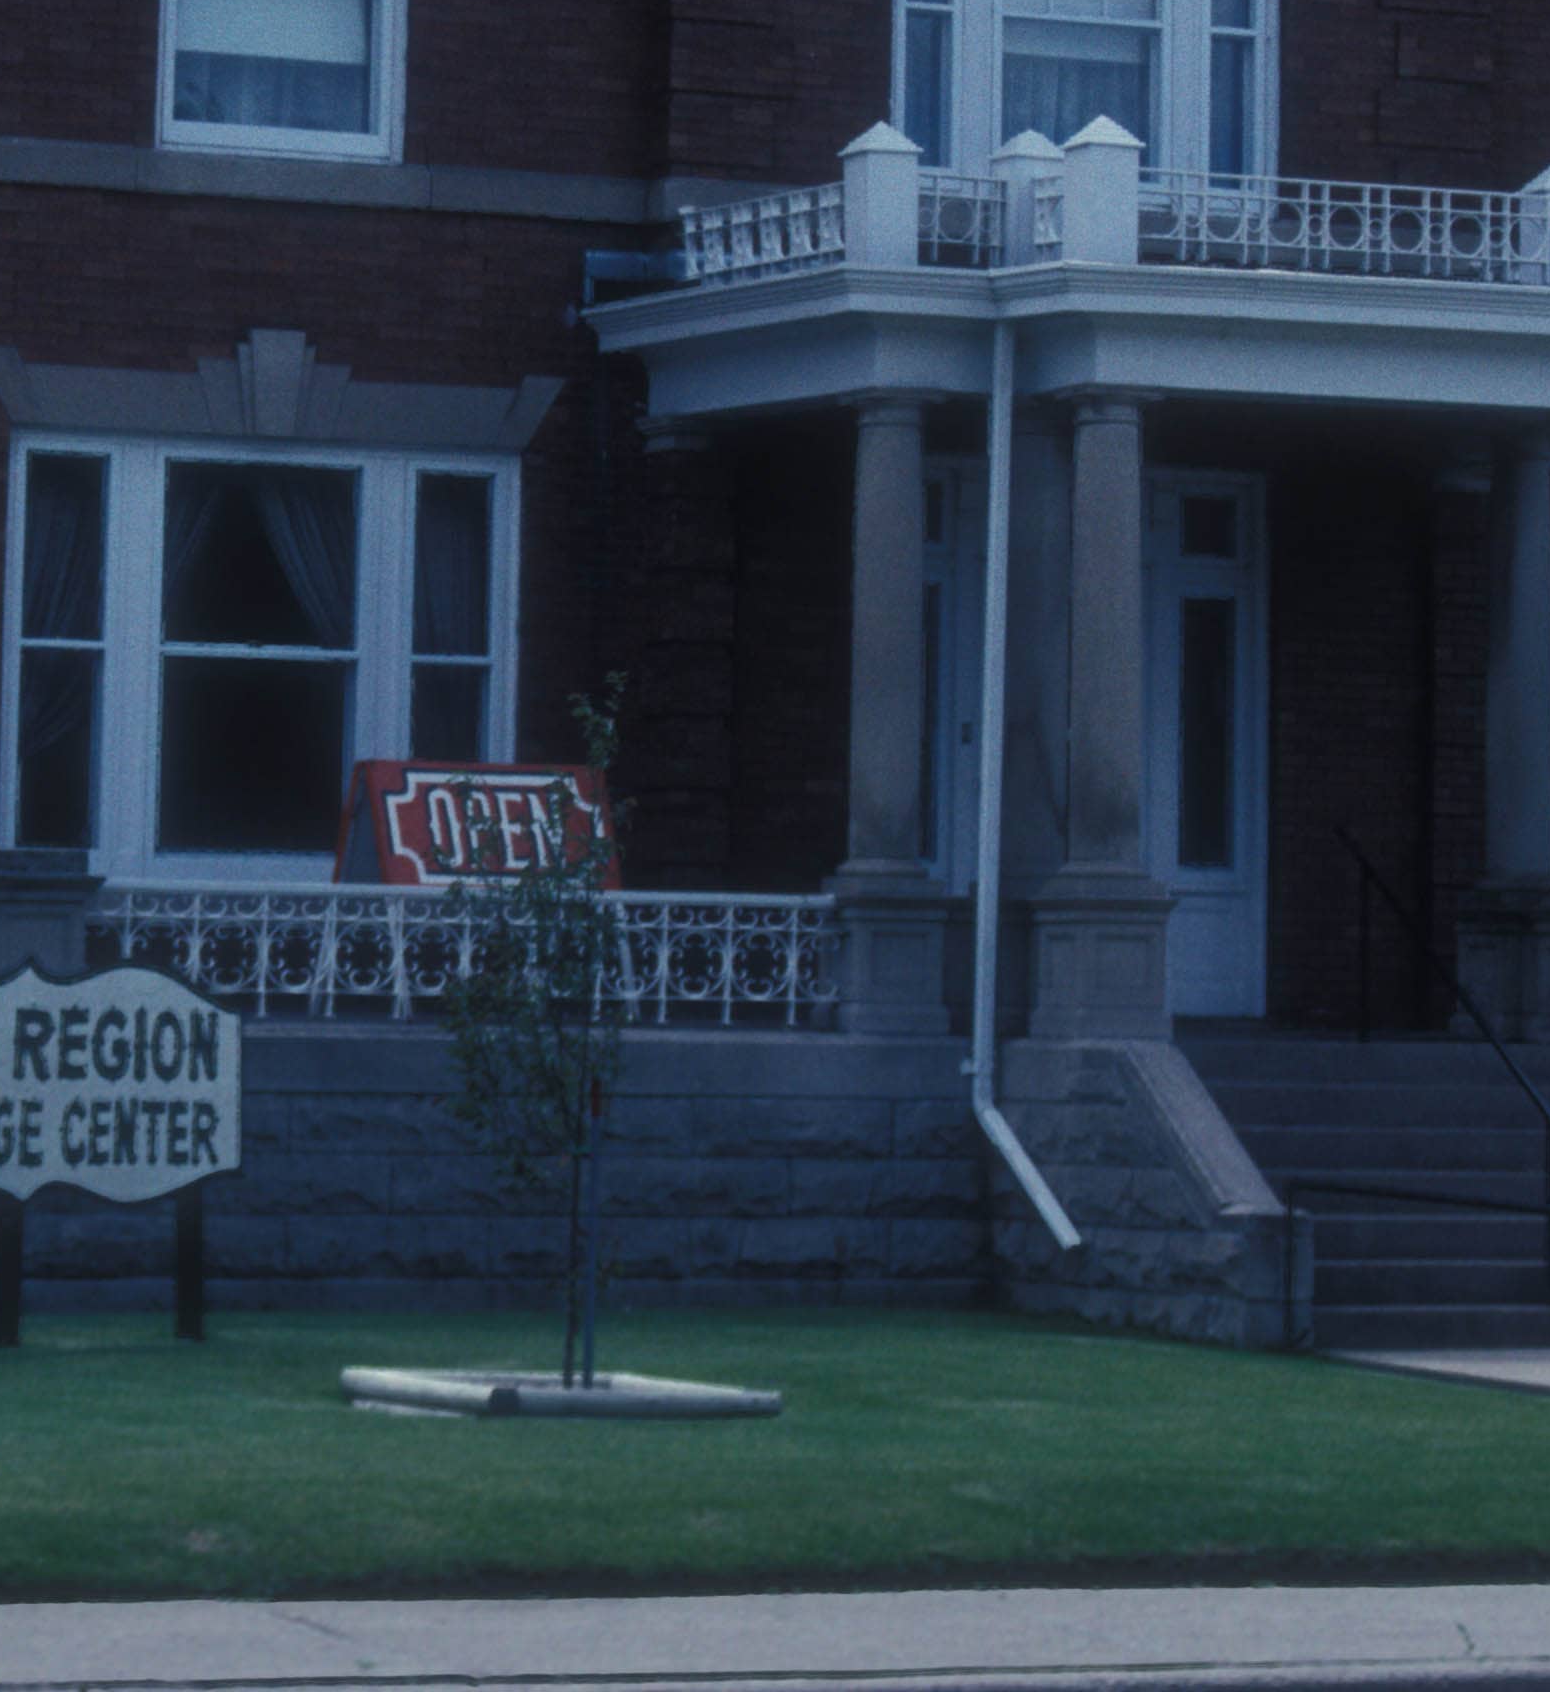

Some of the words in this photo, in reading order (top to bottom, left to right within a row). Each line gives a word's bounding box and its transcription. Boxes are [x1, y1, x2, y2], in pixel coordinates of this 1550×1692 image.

[427, 787, 567, 870] OPEN
[12, 1005, 220, 1082] REGION
[58, 1097, 220, 1169] CENTER
